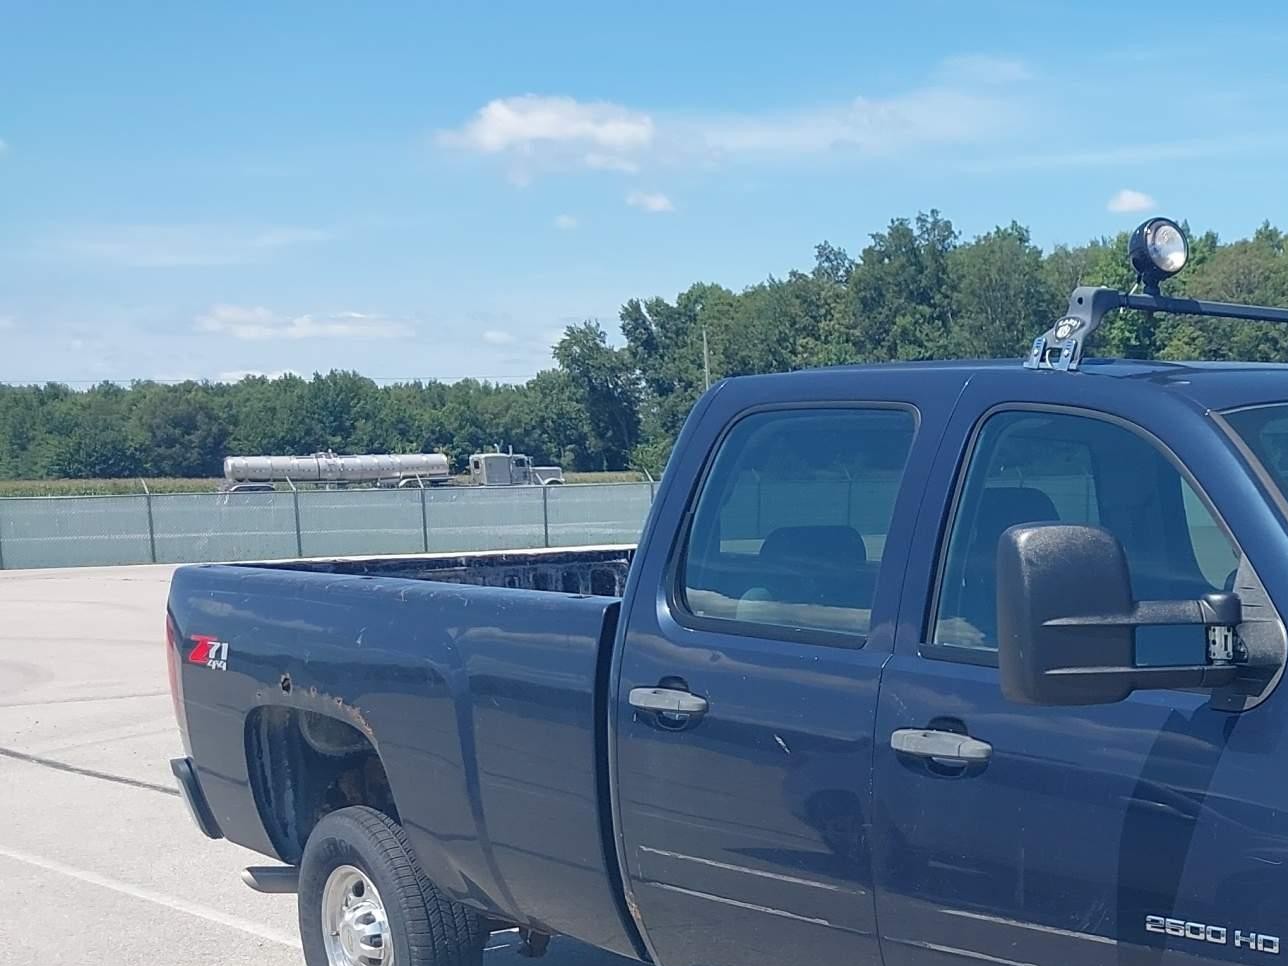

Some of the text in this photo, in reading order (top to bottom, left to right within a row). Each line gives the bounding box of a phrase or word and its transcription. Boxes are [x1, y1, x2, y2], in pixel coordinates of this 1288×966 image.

[189, 634, 229, 663] Z71
[1145, 915, 1227, 944] 2500
[1234, 930, 1280, 955] HD
